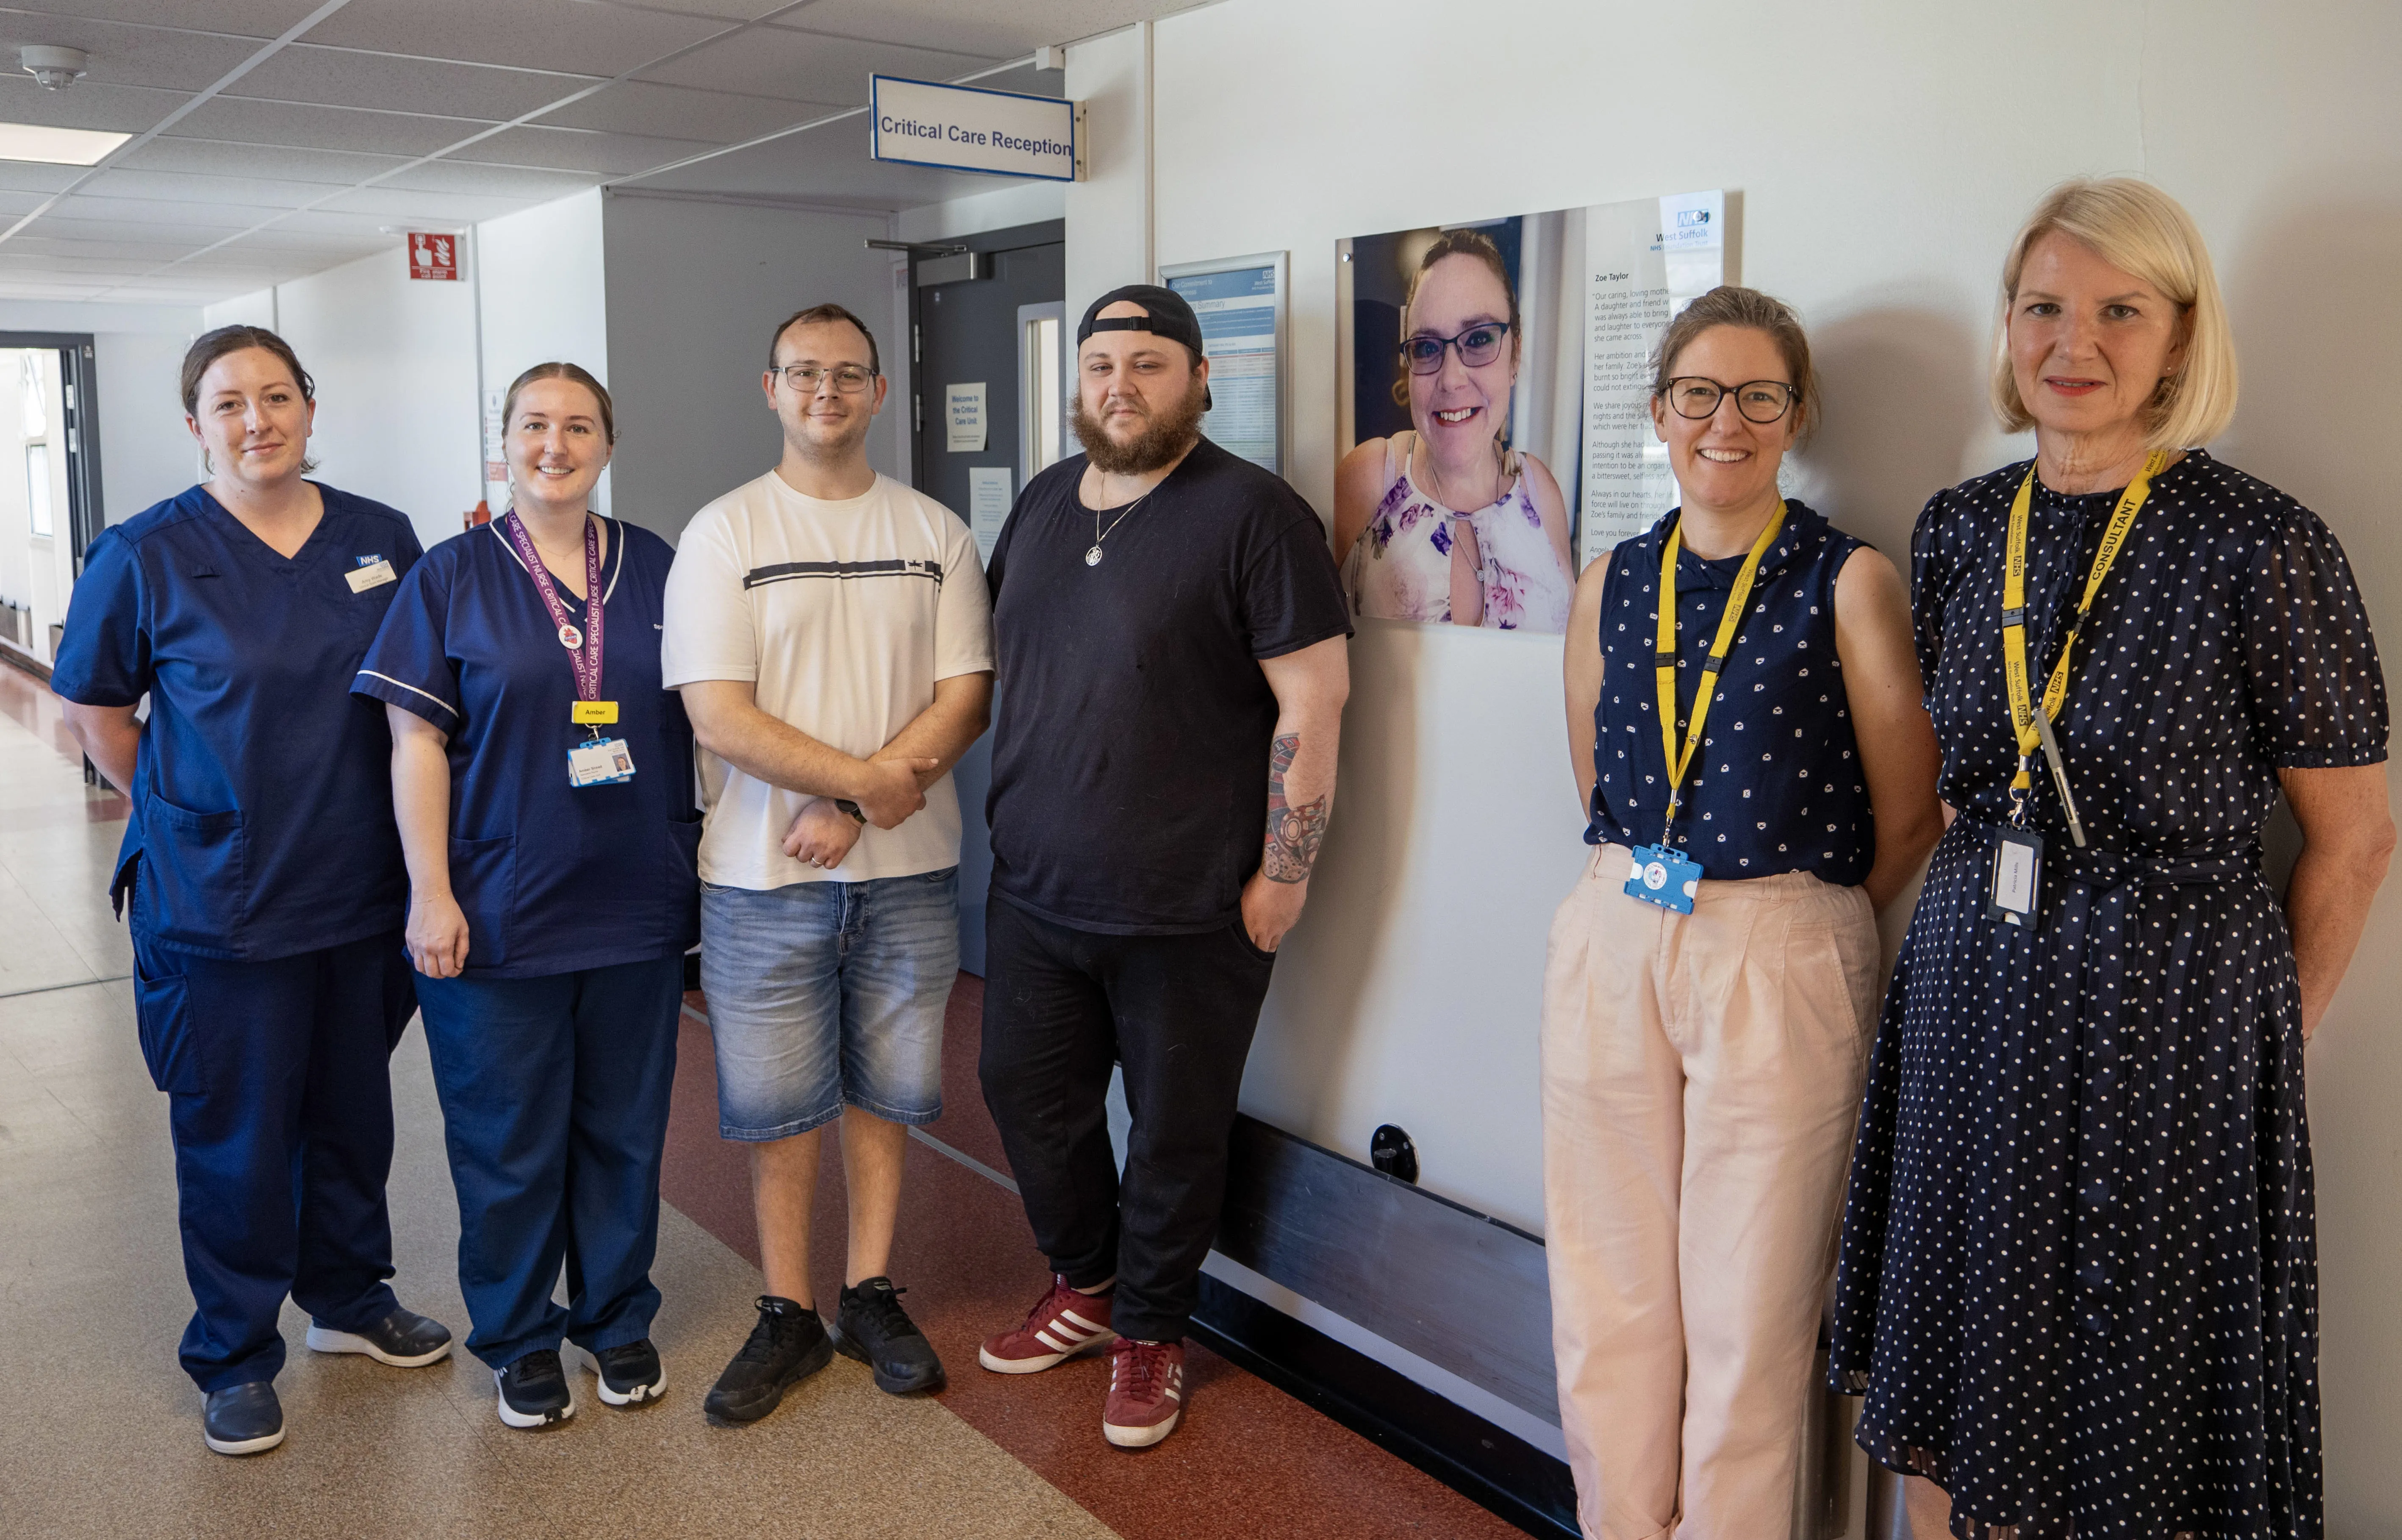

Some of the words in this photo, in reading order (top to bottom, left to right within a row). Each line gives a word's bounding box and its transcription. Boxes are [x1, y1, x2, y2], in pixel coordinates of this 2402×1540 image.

[881, 116, 942, 139] Critical
[949, 126, 986, 145] Care
[992, 131, 1071, 156] Reception
[1656, 233, 1676, 241] West
[1678, 228, 1708, 240] Suffolk
[1609, 272, 1629, 282] Taylor
[1608, 291, 1628, 300] caring,
[1630, 290, 1648, 298] loving
[1198, 300, 1225, 309] Summary
[1601, 302, 1628, 311] daughter
[1630, 300, 1641, 308] and
[1643, 298, 1661, 307] friend
[1608, 313, 1628, 321] always
[1652, 310, 1668, 318] bring
[1607, 322, 1632, 332] laughter
[1606, 351, 1632, 359] ambition
[1634, 350, 1645, 358] and
[1620, 372, 1638, 381] bright
[1593, 383, 1609, 391] could
[961, 405, 978, 413] Critical
[1622, 402, 1641, 411] joyous
[1593, 413, 1611, 421] nights
[1637, 412, 1648, 420] silly
[1592, 441, 1620, 450] Although
[1592, 452, 1614, 460] passing
[2145, 459, 2156, 472] West
[1591, 490, 1612, 498] Always
[1641, 501, 1665, 511] through
[1607, 511, 1625, 520] family
[1626, 511, 1638, 519] and
[2092, 498, 2136, 580] CONSULTANT
[360, 555, 380, 565] NHS
[510, 515, 521, 533] CARE
[516, 531, 538, 564] SPECIALIST
[533, 564, 549, 587] NURSE
[544, 588, 563, 617] CRITICAL
[589, 557, 597, 583] CRITICAL
[2013, 556, 2022, 577] NHS
[591, 585, 599, 606] NURSE
[1729, 604, 1741, 622] NHS
[591, 607, 599, 645] SPECIALIST
[589, 646, 598, 666] CARE
[589, 667, 598, 699] CRITICAL
[2050, 671, 2064, 694] NHS
[2015, 679, 2023, 702] Suffolk
[2017, 704, 2029, 726] NHS
